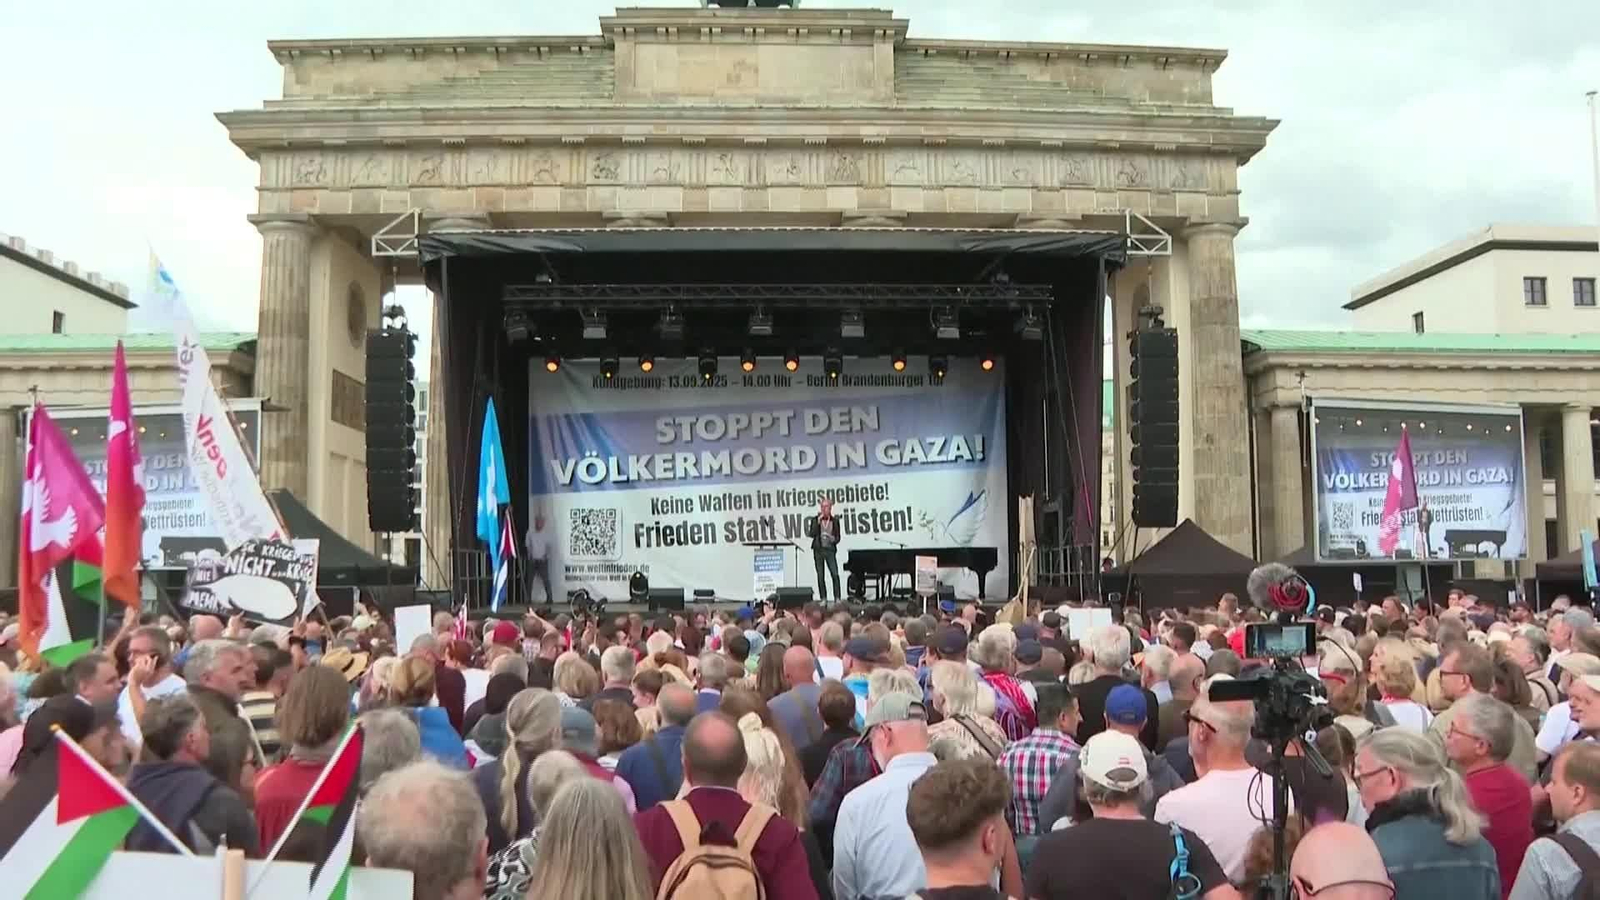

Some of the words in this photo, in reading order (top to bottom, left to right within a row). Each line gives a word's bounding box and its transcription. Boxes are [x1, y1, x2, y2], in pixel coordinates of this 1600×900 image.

[669, 374, 728, 388] 13.09.2025
[743, 374, 771, 387] 14.00
[774, 373, 792, 387] Uhr
[842, 373, 924, 388] Brandenburger
[656, 409, 796, 444] STOPPT
[804, 405, 880, 436] DEN
[551, 446, 817, 486] VÖLKERMORD
[826, 441, 867, 469] IN
[875, 433, 985, 467] GAZA!
[1371, 452, 1430, 467] STPT
[1435, 449, 1468, 465] DEN
[1324, 469, 1440, 489] VÖLKERRD
[1444, 469, 1462, 485] IN
[1466, 467, 1514, 484] GAZA!
[651, 496, 694, 515] Keine
[699, 492, 752, 512] Waffen
[757, 490, 771, 508] in
[777, 483, 889, 508] Kriegsgebiete!
[1369, 496, 1387, 507] Kein
[634, 519, 717, 548] Frieden
[724, 515, 776, 543] statt
[783, 507, 913, 540] Weüsten!
